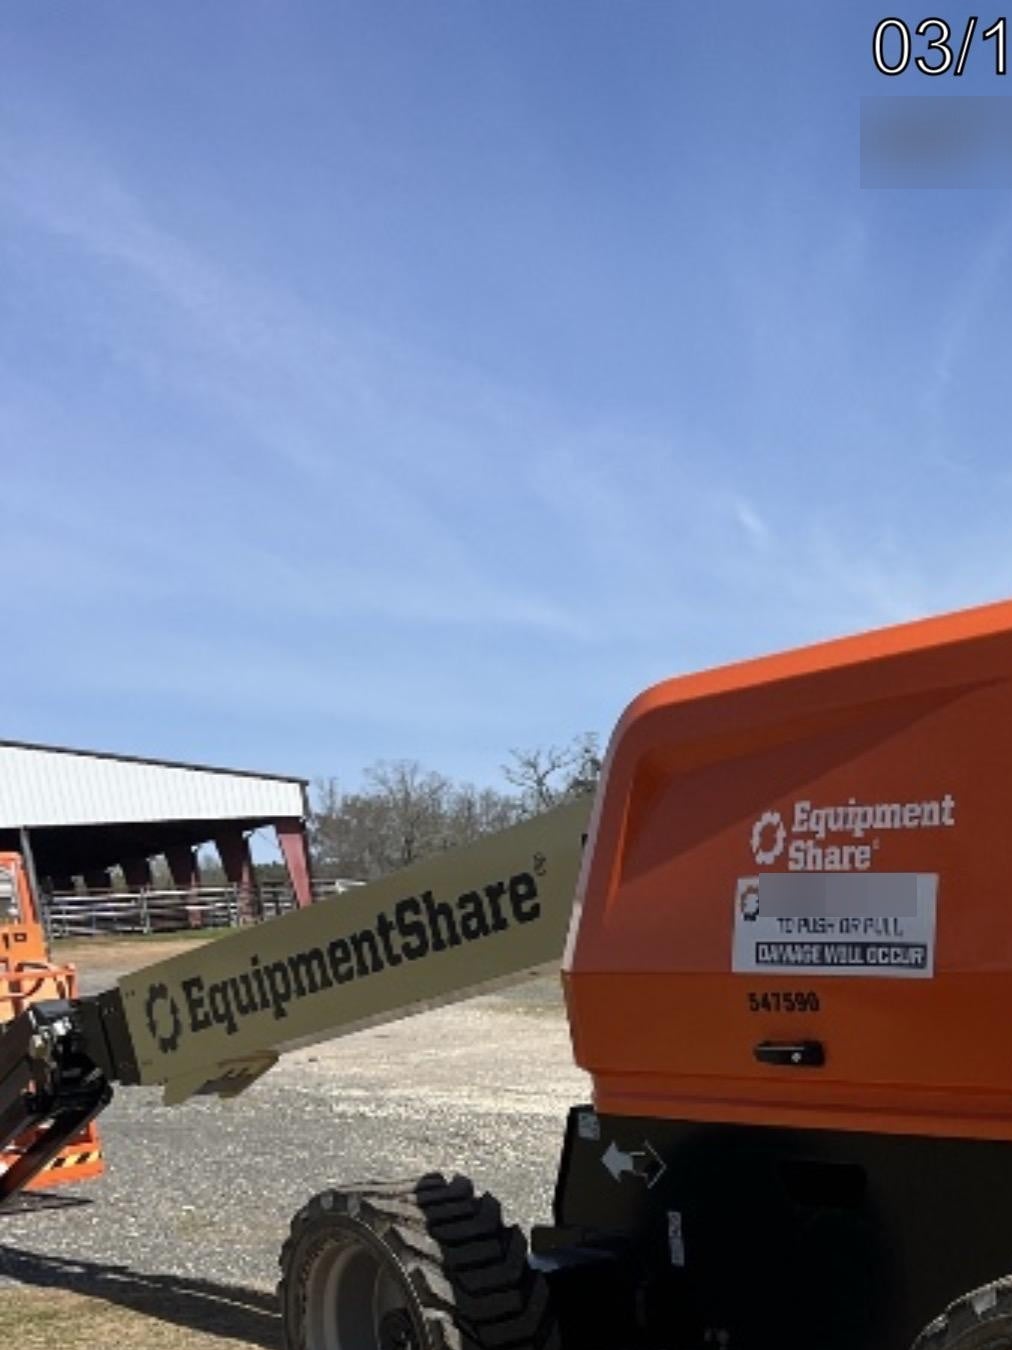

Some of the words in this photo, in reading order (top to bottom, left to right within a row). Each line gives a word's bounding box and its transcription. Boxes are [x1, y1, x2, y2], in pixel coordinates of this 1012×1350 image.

[792, 794, 955, 839] Equipment
[788, 838, 872, 871] Share
[182, 870, 542, 1036] EquipmentShare
[758, 943, 821, 964] DAMAGE
[823, 943, 865, 965] WILL
[866, 945, 925, 966] OCCUR
[747, 990, 821, 1012] 547590
